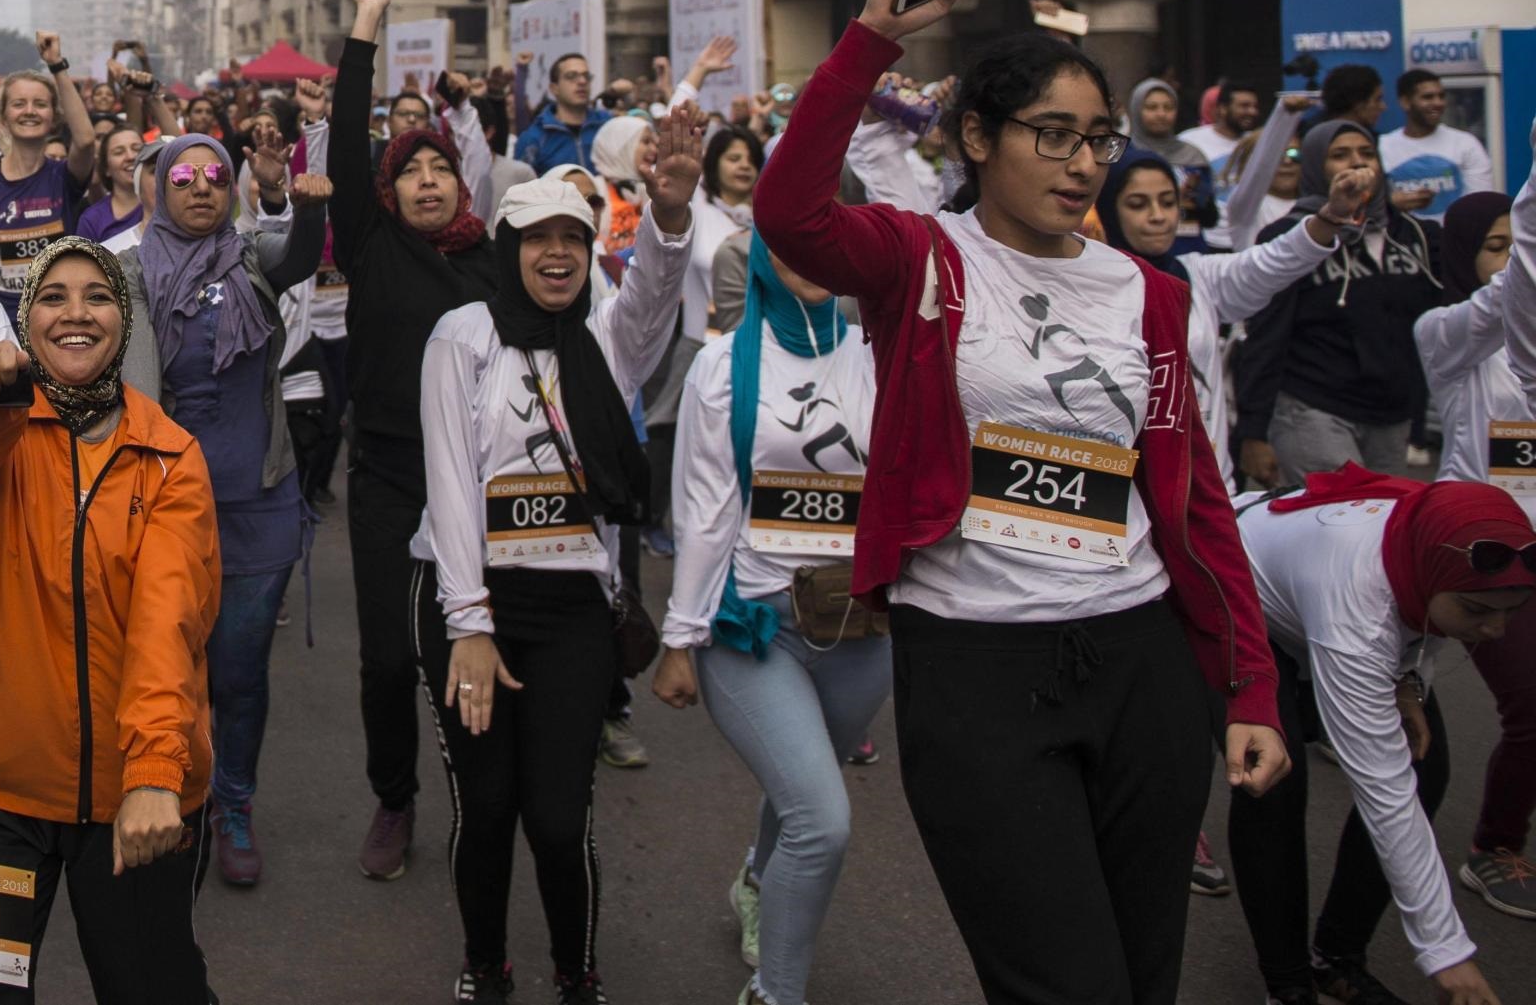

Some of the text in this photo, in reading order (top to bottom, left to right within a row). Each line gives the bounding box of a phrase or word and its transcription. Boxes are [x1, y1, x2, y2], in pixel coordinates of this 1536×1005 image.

[1411, 32, 1479, 63] dasani
[983, 431, 1128, 472] WOMEN RACE 2018
[490, 481, 567, 494] WOMEN RACE
[757, 475, 808, 486] WOMEN
[810, 478, 844, 489] RACE
[1004, 459, 1086, 510] 254
[512, 496, 566, 527] 082
[780, 490, 844, 521] 288
[2, 880, 28, 893] 2018
